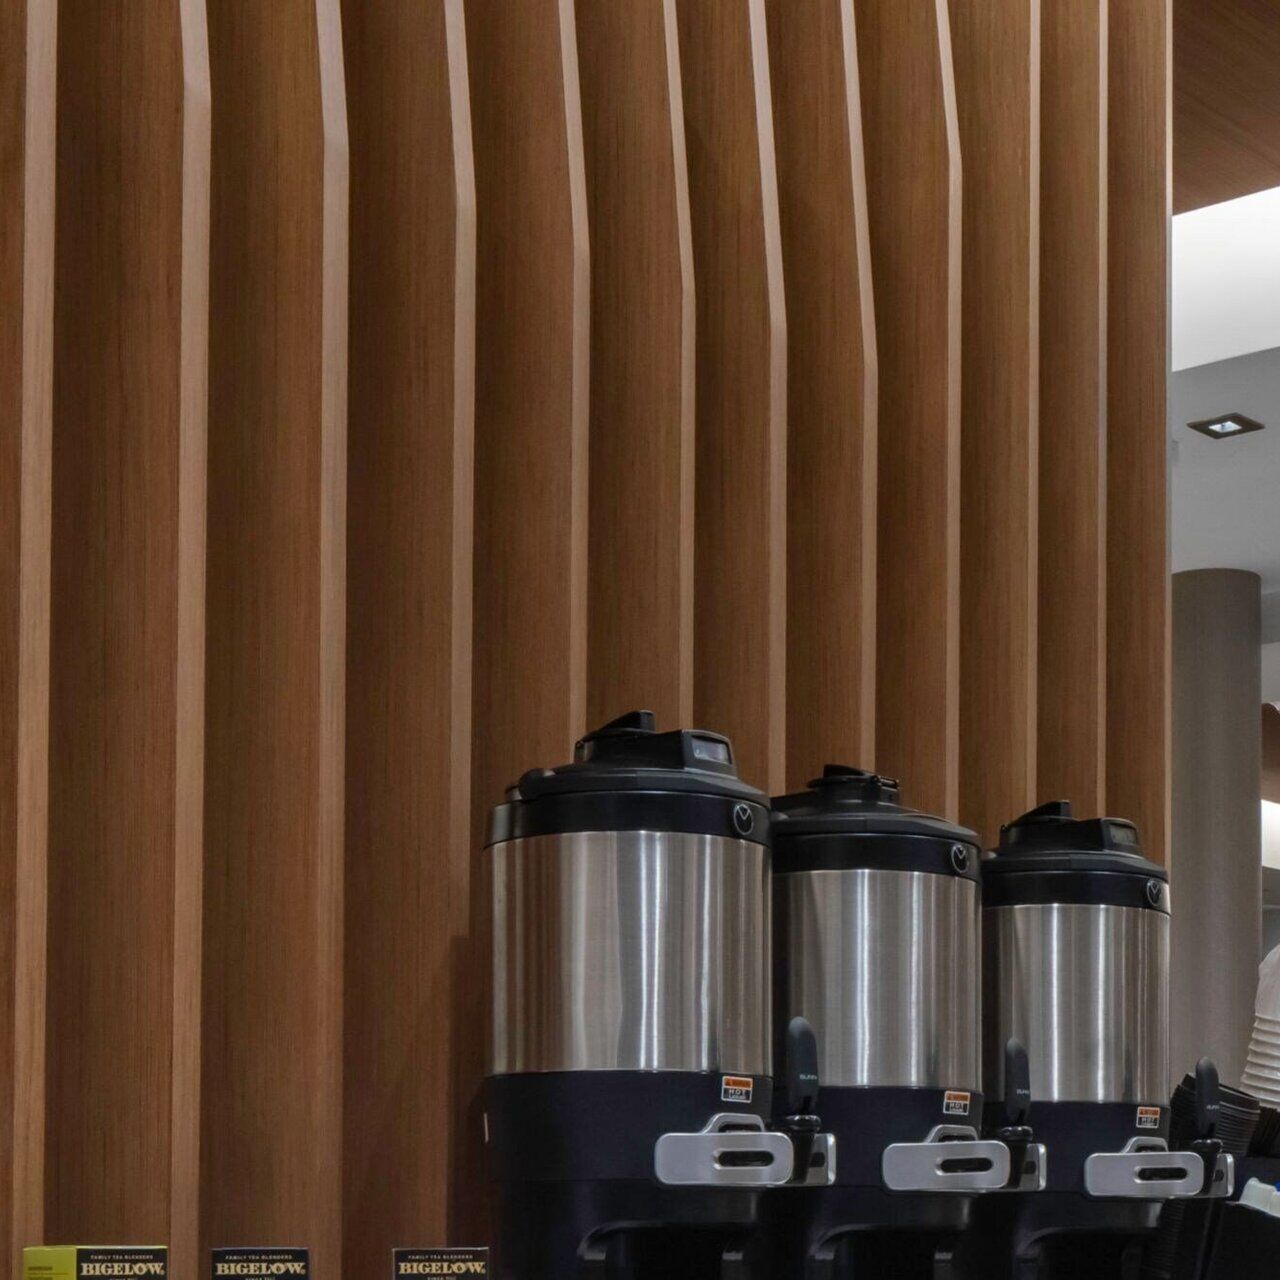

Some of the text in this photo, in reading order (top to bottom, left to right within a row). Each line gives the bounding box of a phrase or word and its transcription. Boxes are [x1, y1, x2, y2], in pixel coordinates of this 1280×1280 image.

[80, 1262, 165, 1275] BIGELOW
[216, 1262, 306, 1275] BIGELOW
[399, 1262, 486, 1274] BIGELOW
